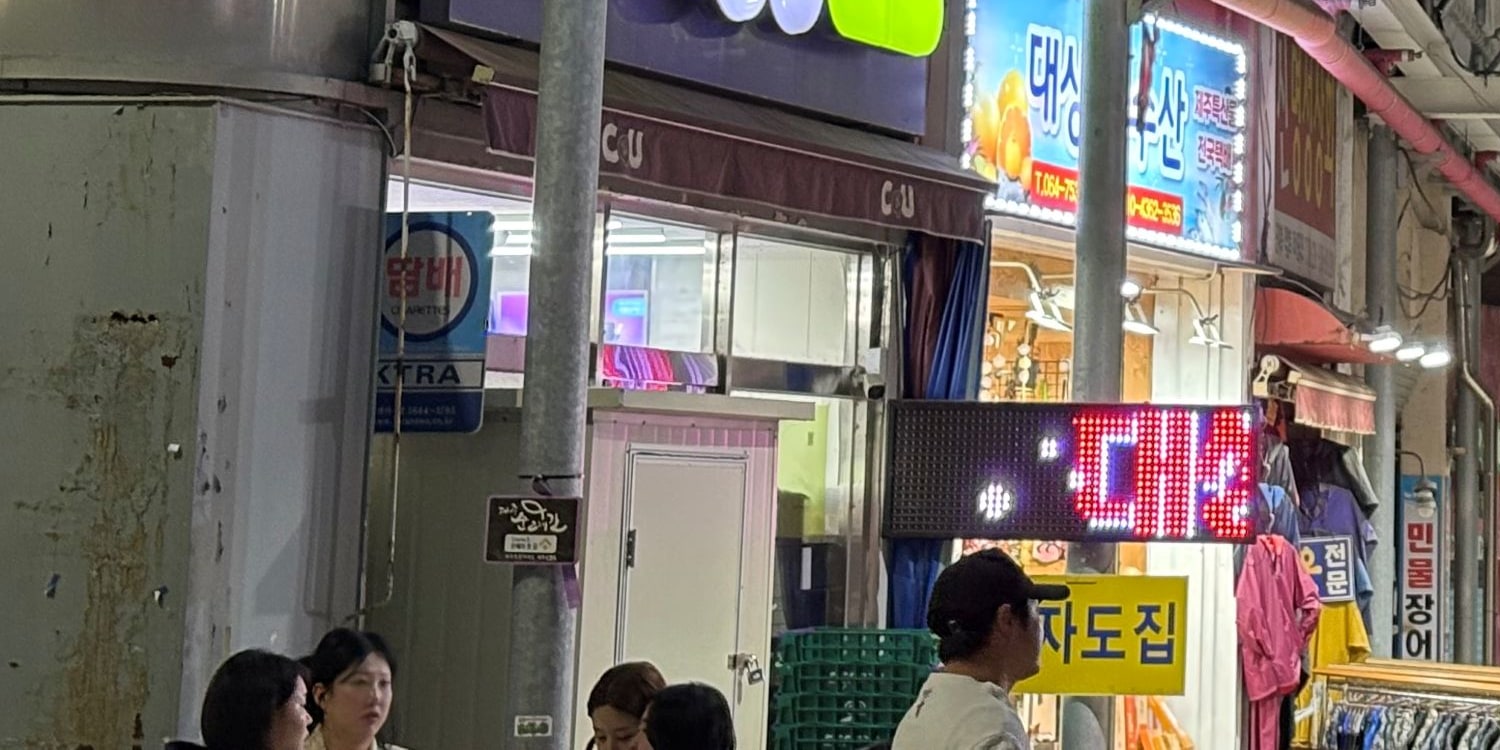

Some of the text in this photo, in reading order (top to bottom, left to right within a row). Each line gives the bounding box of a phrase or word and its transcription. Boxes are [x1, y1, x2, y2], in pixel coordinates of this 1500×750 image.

[602, 122, 643, 169] CU
[881, 180, 914, 218] CU
[391, 304, 450, 315] CIARETTES
[1324, 542, 1349, 596] 전문
[1405, 522, 1434, 660] 민물장어
